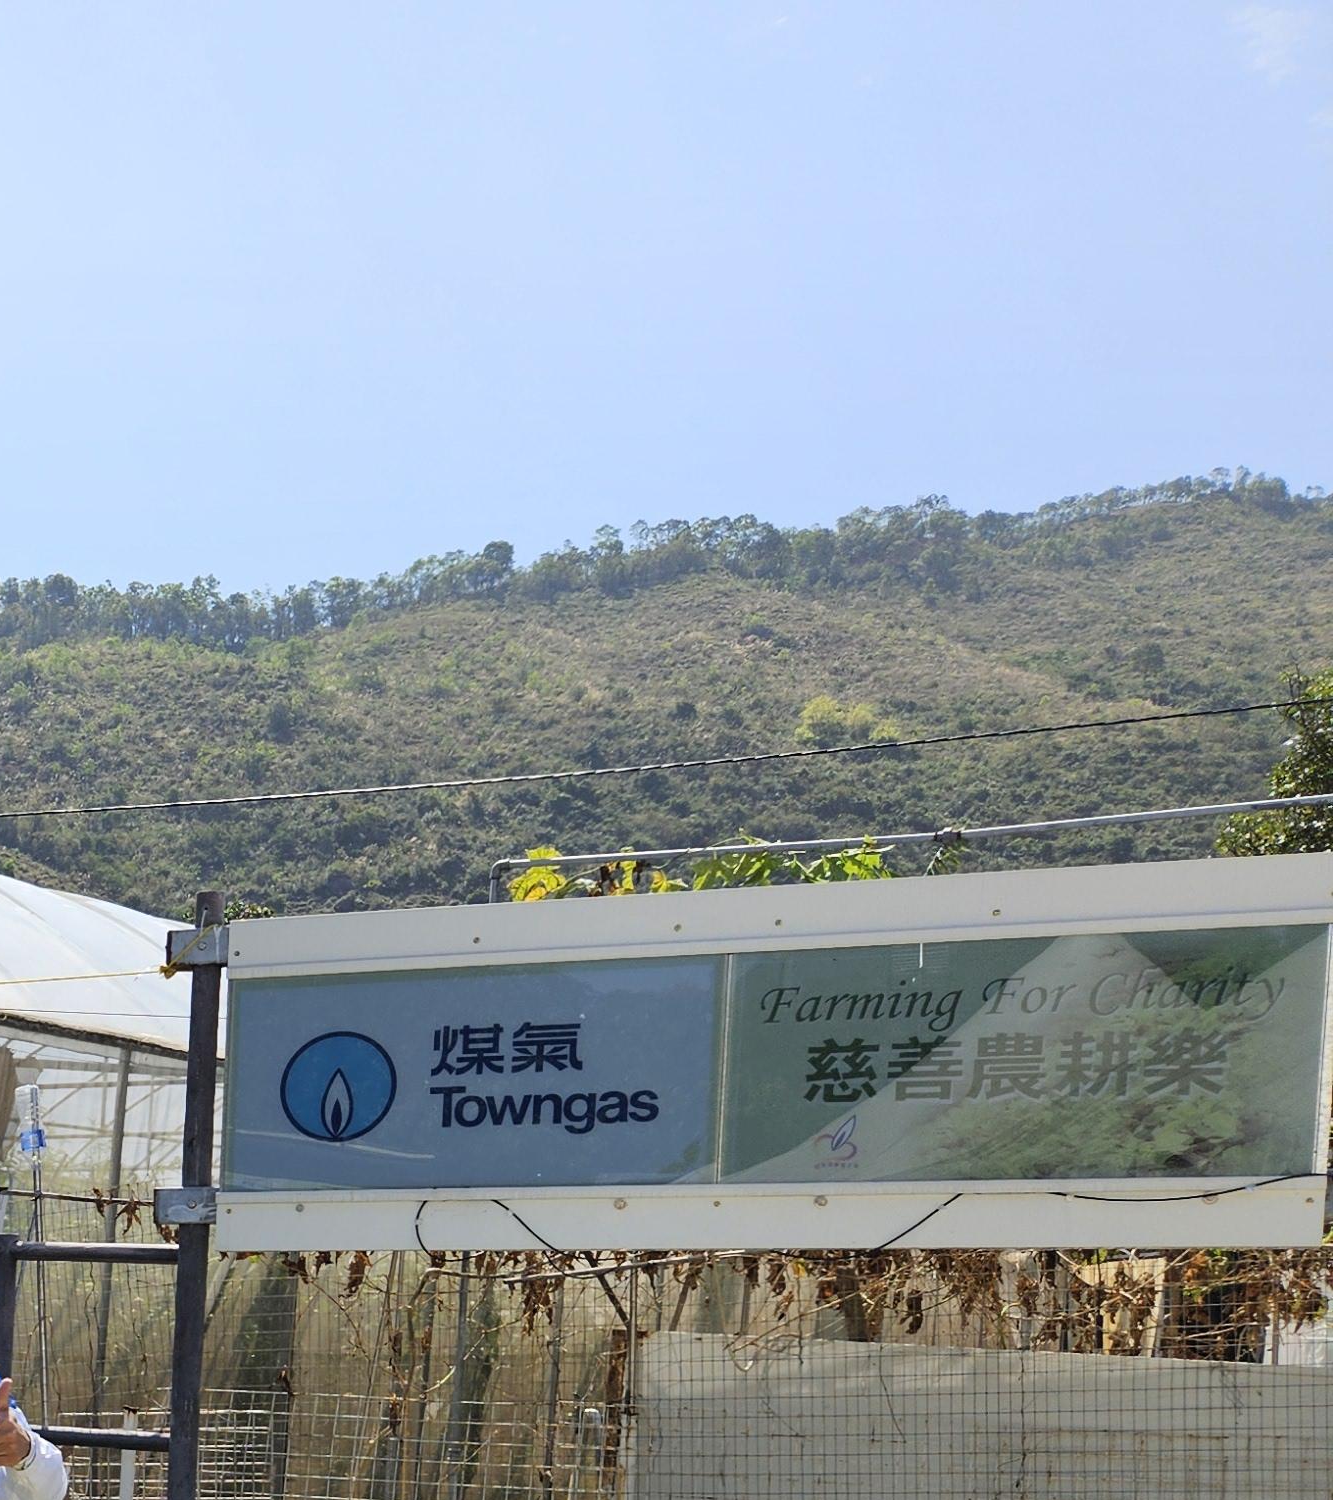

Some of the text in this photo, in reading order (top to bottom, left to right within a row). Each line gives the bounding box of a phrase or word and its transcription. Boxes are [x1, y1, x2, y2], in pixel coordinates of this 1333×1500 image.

[760, 971, 1287, 1031] Farming For Charity
[431, 1022, 583, 1076] 煤氣
[804, 1030, 1232, 1103] 慈善農耕樂
[430, 1086, 659, 1134] Towngas
